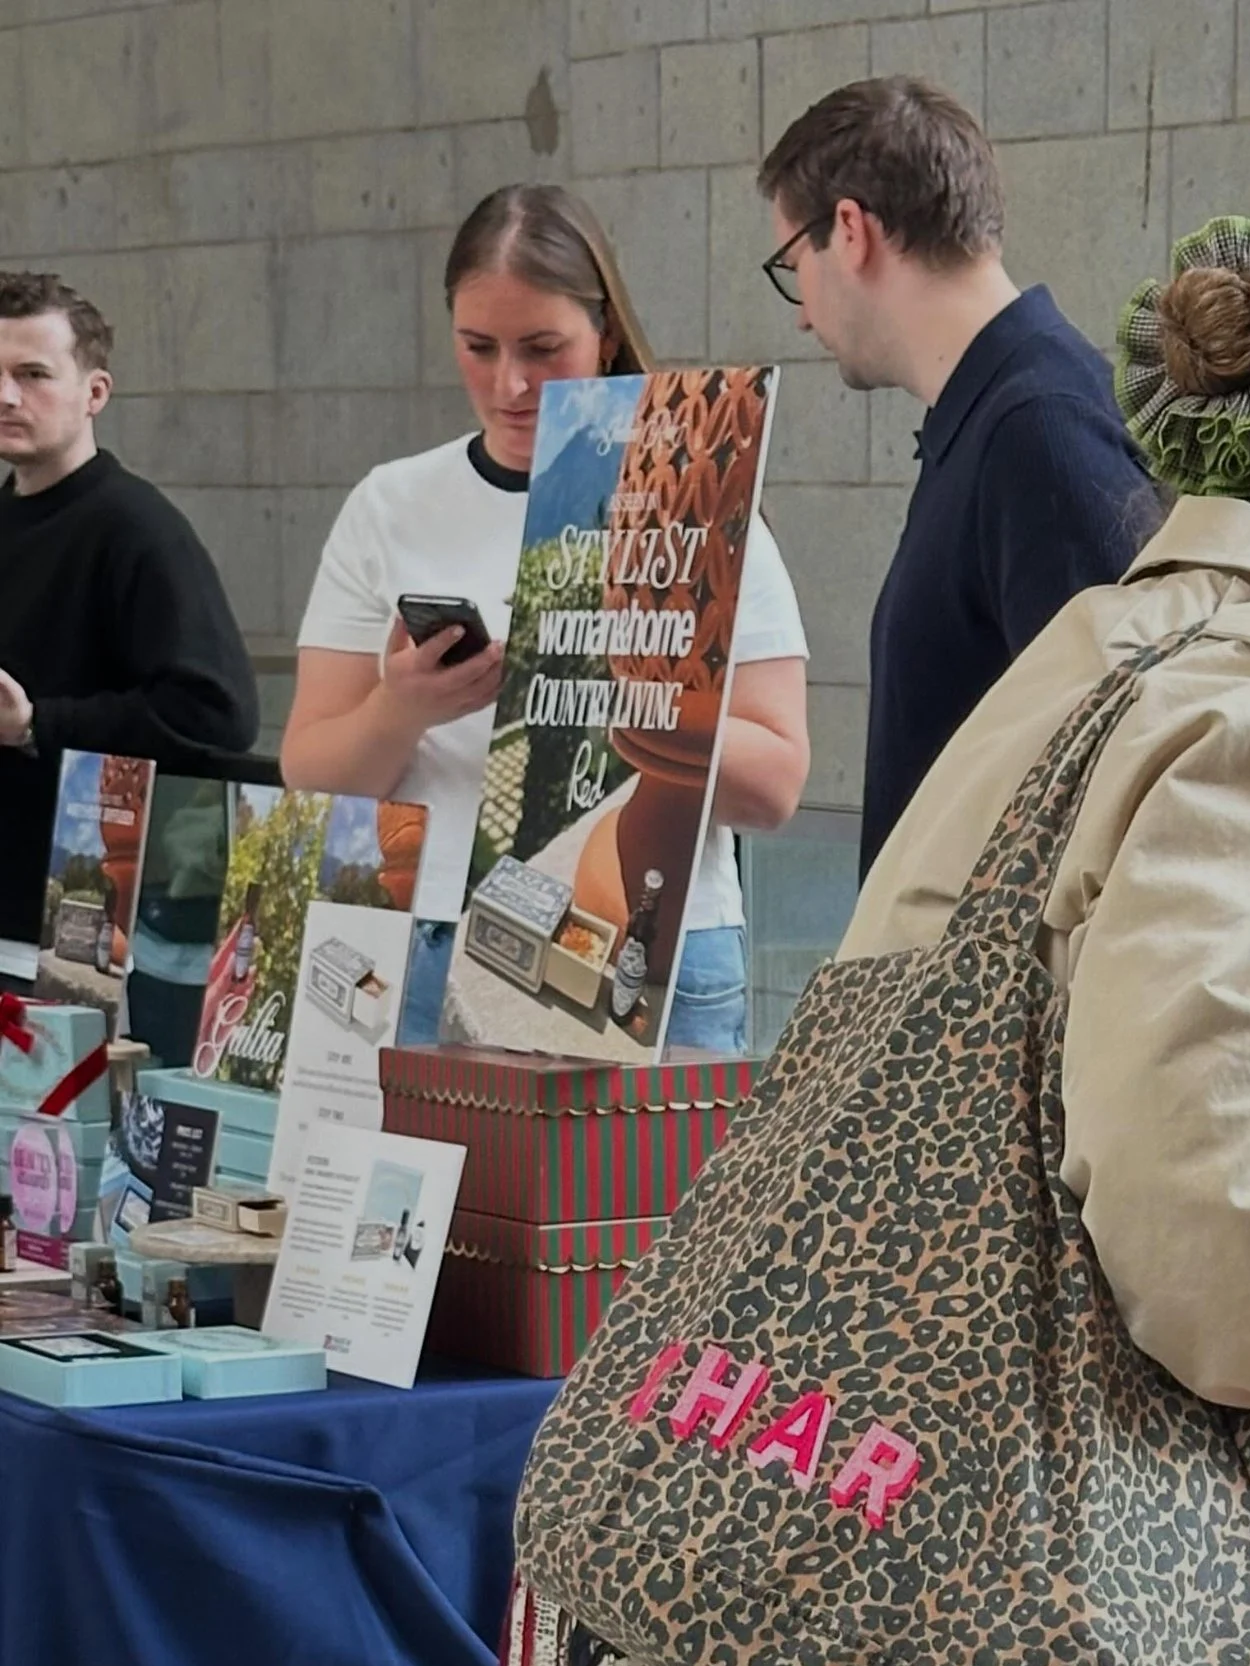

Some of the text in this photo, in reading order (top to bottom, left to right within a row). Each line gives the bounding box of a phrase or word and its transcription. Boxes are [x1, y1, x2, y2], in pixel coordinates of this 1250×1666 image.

[546, 521, 709, 590] STYLIST
[537, 598, 697, 659] woman&home
[525, 673, 684, 731] COUNTRY LIVING
[566, 740, 608, 812] Red
